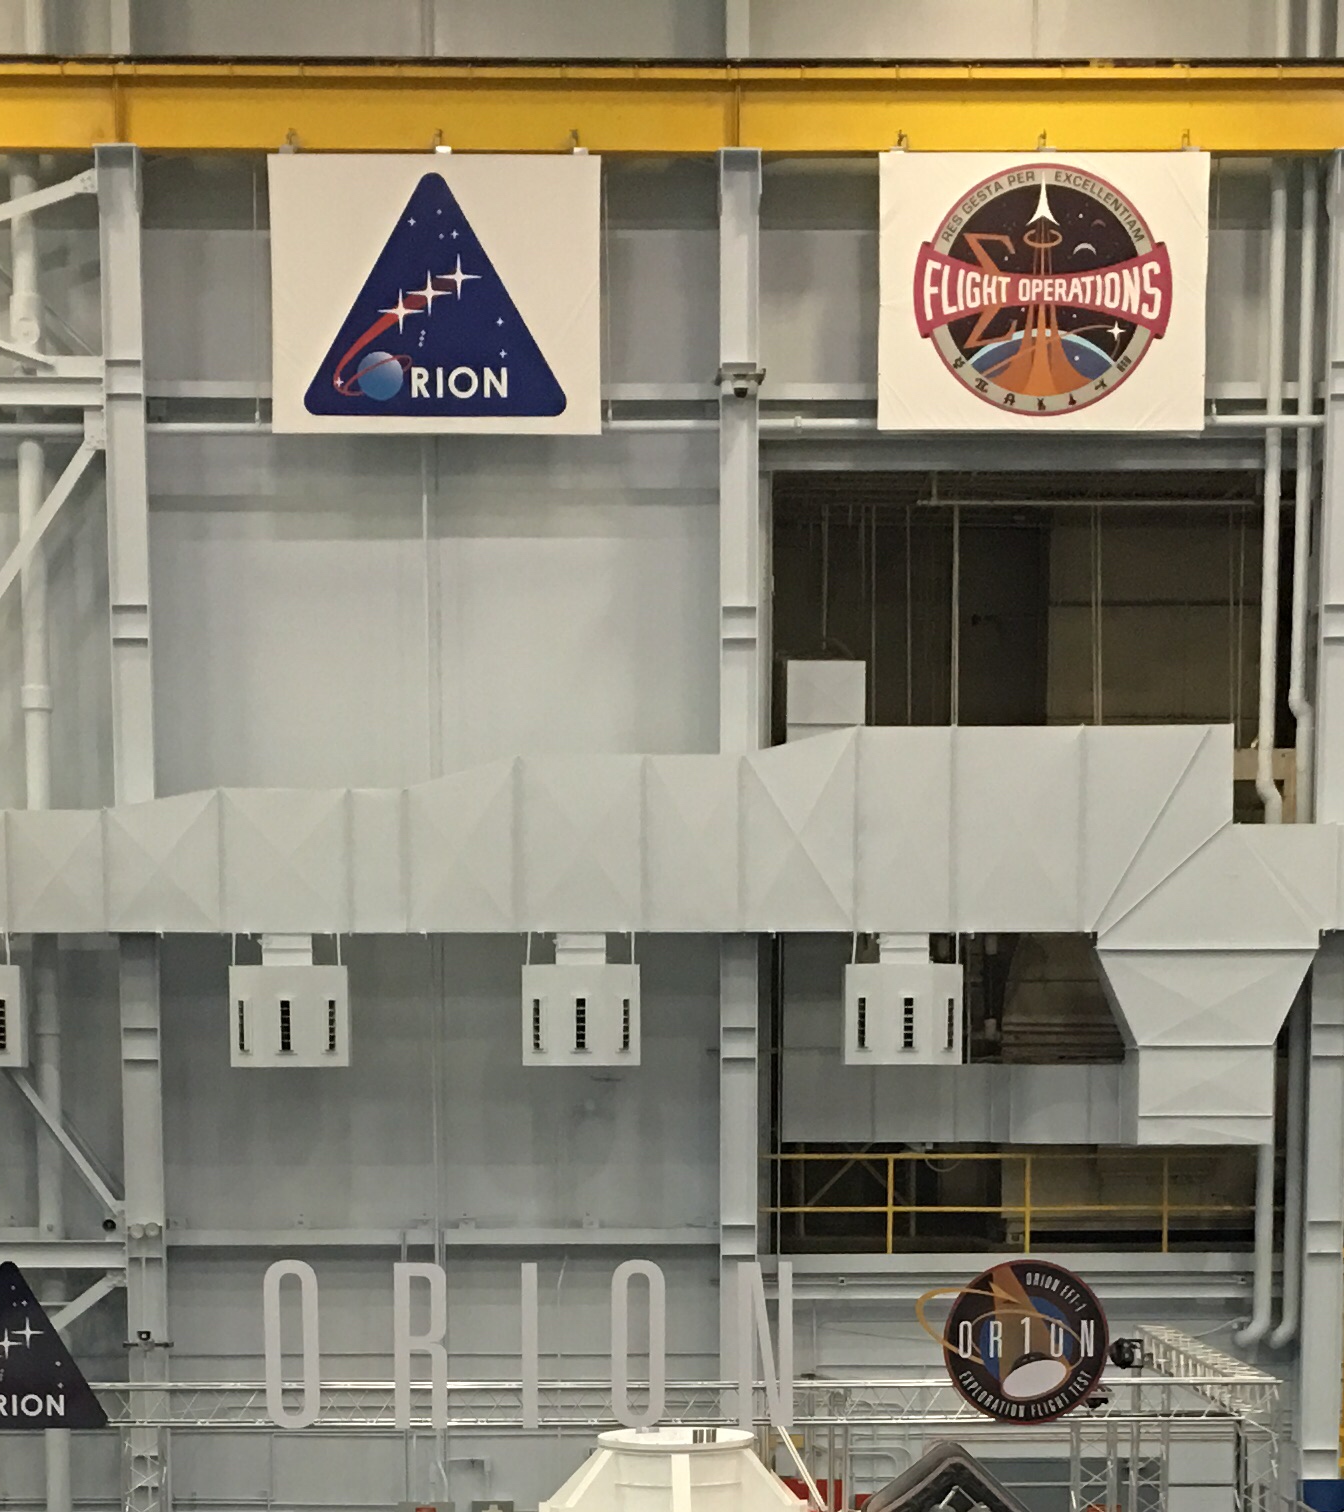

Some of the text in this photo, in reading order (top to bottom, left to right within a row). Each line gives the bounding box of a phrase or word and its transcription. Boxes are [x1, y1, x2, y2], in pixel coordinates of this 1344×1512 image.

[941, 170, 1146, 243] RES GESTA PER EXCELLENTIAM
[923, 258, 1163, 322] FLIGHT OPERATIONS
[1025, 1271, 1088, 1313] ORION EFT-1
[262, 1259, 793, 1430] ORION
[958, 1369, 1094, 1419] EXPLORATION FLIGHT TEST
